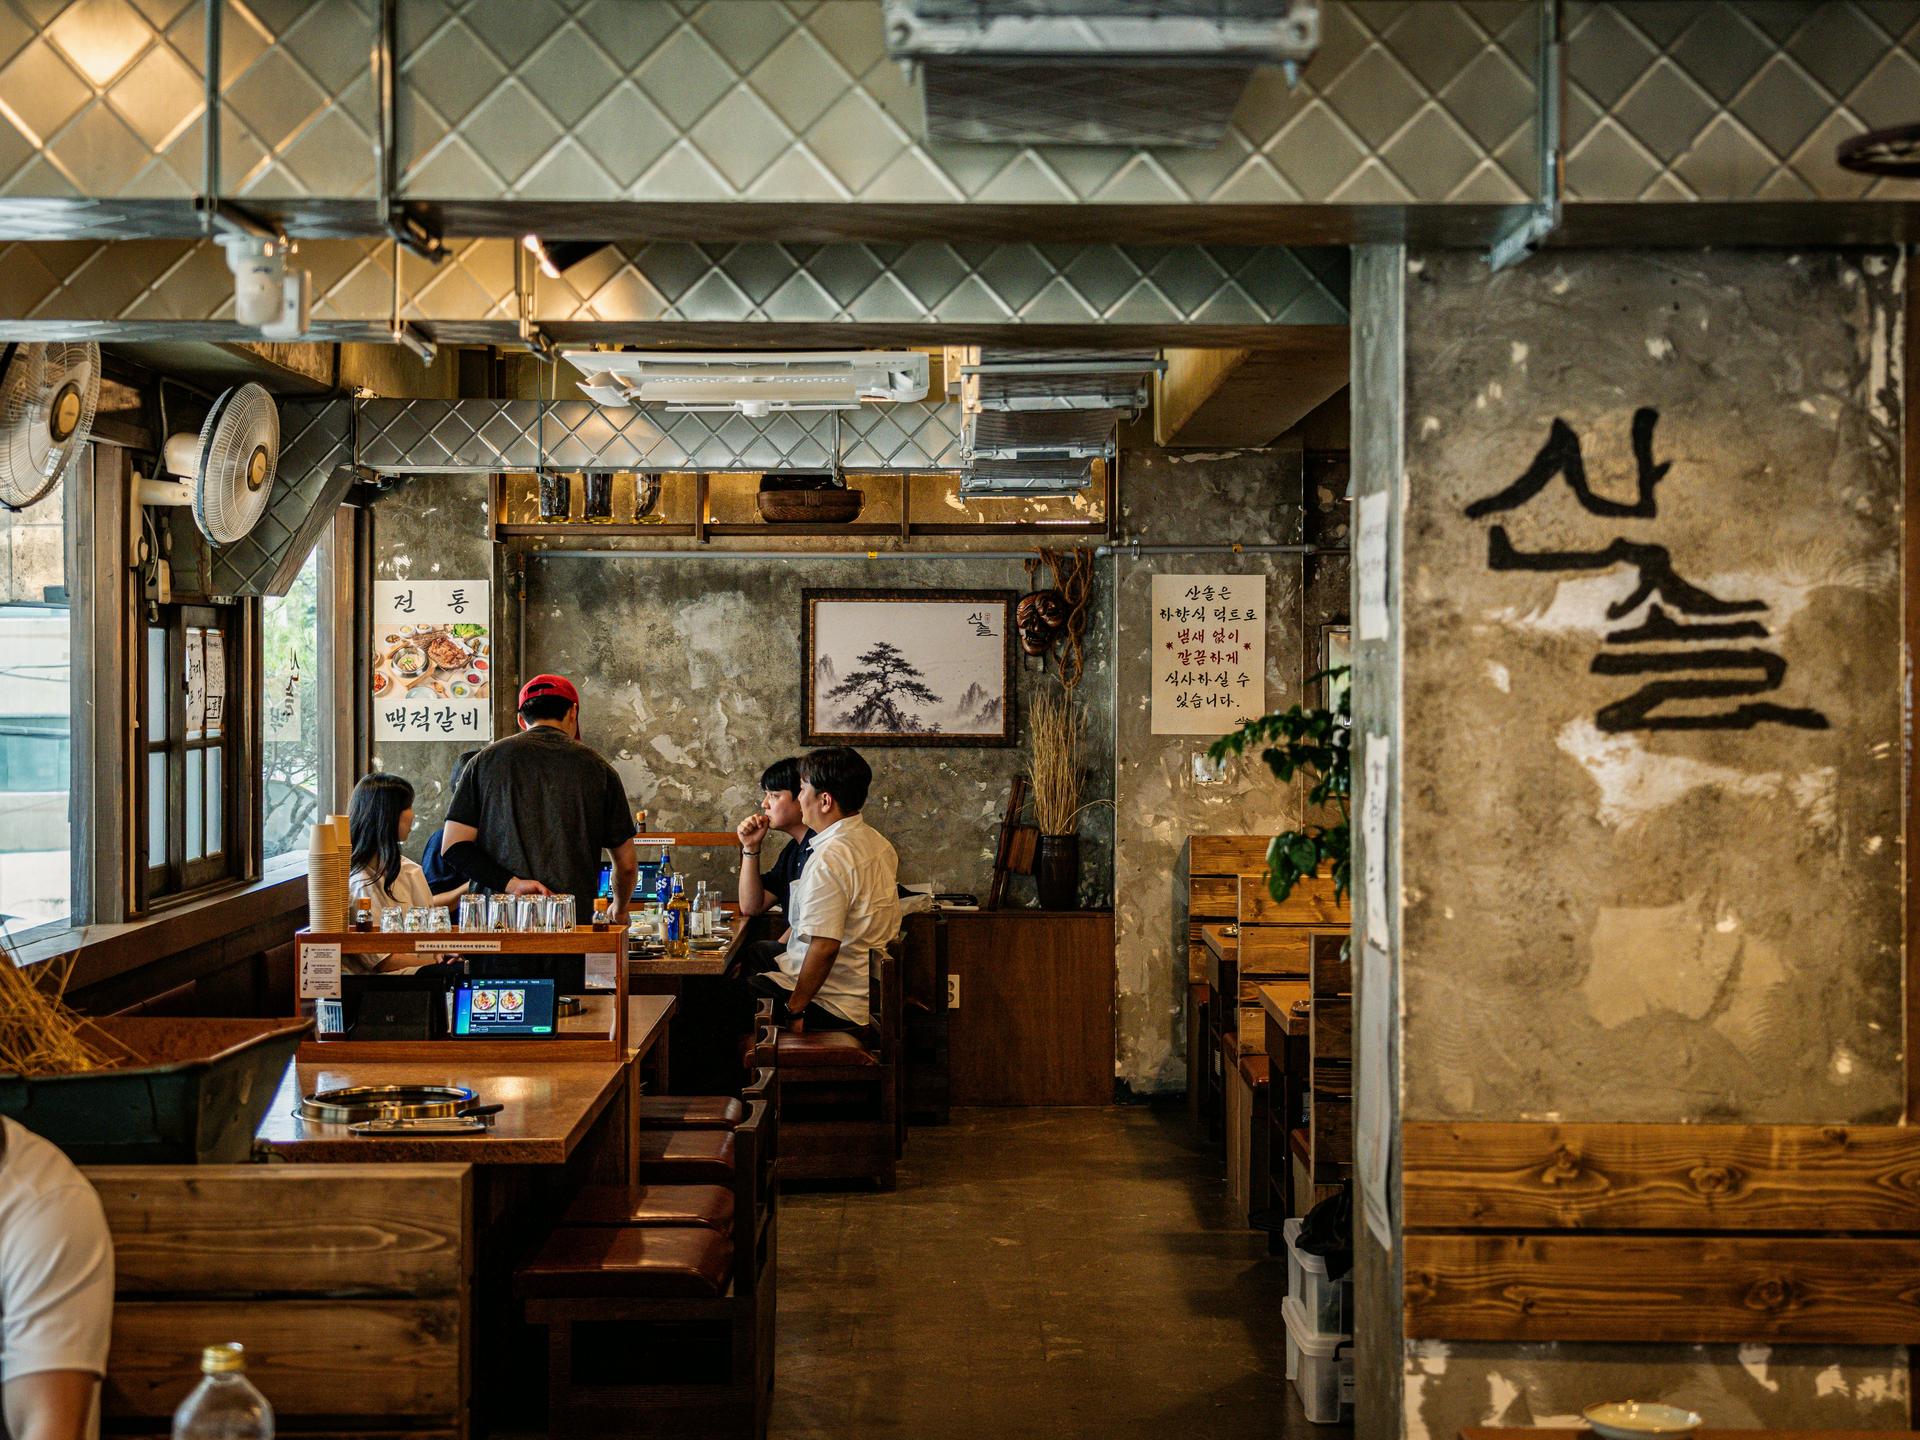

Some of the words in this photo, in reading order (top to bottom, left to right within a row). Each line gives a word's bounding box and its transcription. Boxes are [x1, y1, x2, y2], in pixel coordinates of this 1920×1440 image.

[1464, 406, 1831, 733] 산솔
[1184, 585, 1232, 602] 산솔은
[1159, 606, 1206, 623] 하향식
[1213, 606, 1258, 623] 덕트로
[1177, 628, 1205, 645] 냄새
[1212, 627, 1239, 645] 없이
[1177, 649, 1239, 666] 깔끔하게
[1164, 670, 1229, 688] 식사하실
[1236, 672, 1251, 688] 수
[1176, 691, 1240, 709] 있습니다.
[385, 706, 479, 733] 맥적갈비
